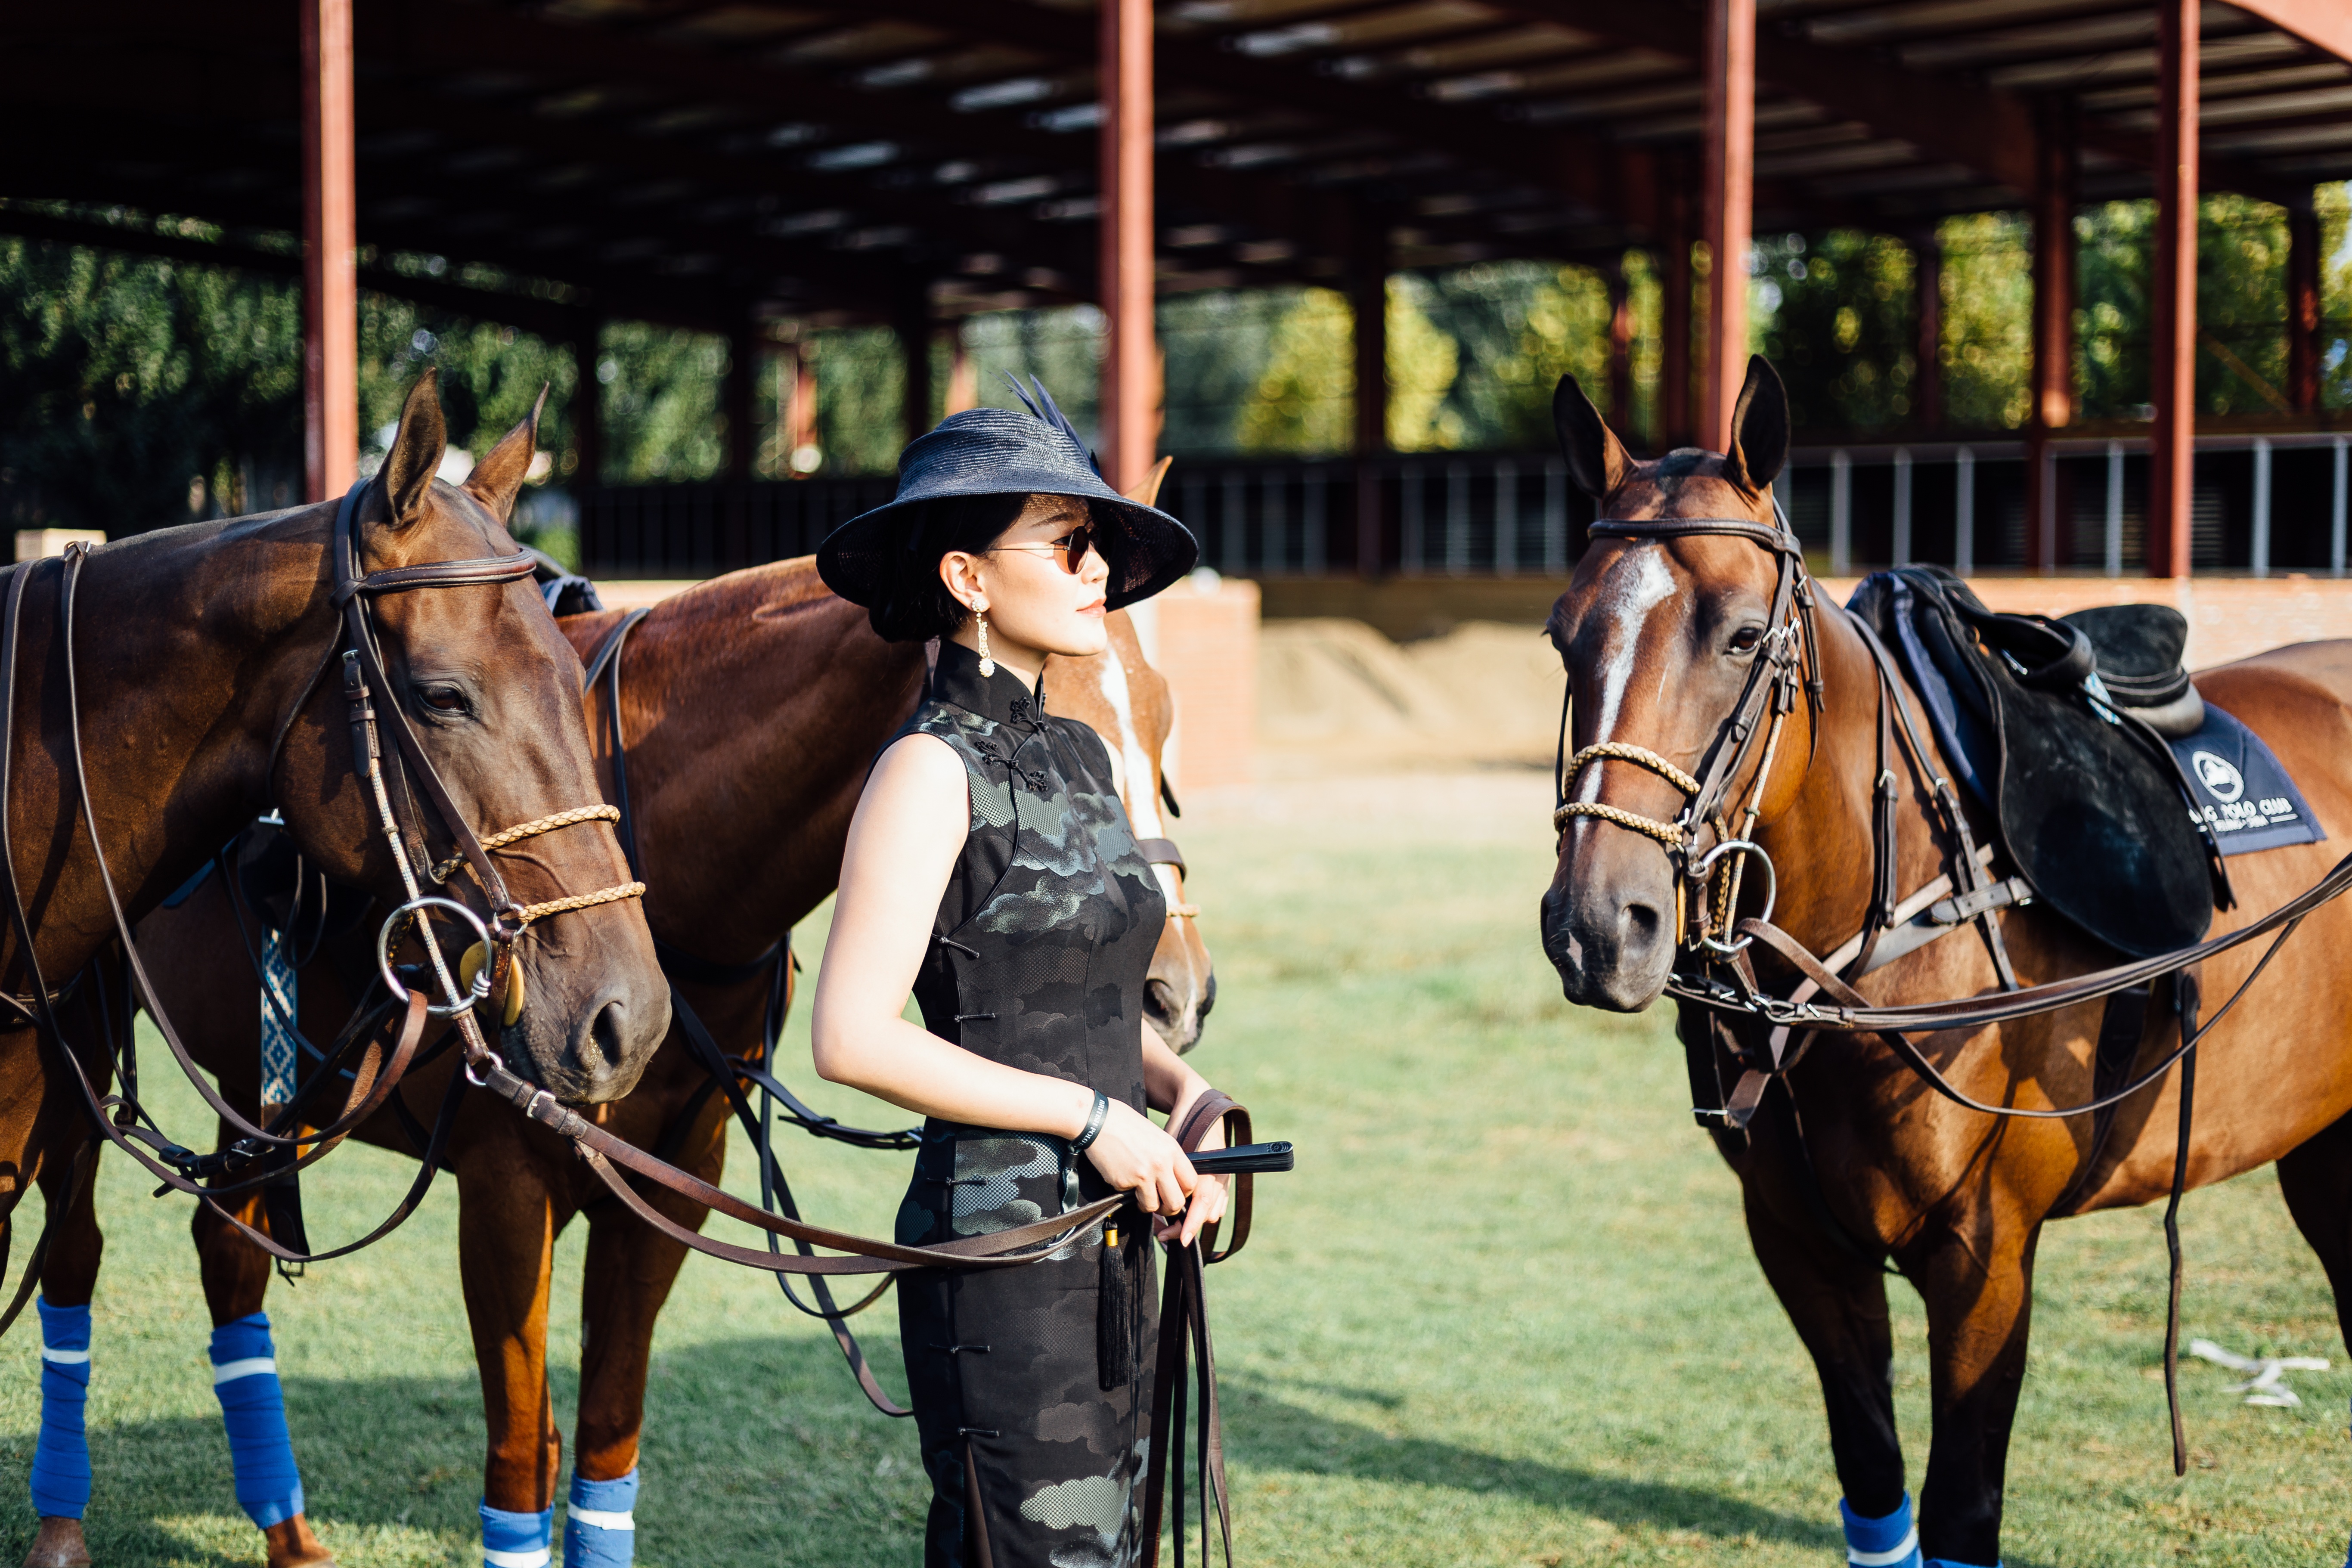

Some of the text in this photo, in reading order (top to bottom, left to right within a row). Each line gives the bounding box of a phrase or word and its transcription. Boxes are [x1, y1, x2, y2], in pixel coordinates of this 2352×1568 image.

[2220, 800, 2257, 819] POLO
[2259, 796, 2293, 815] CLUB
[1081, 1099, 1105, 1143] BRITISH POLO
